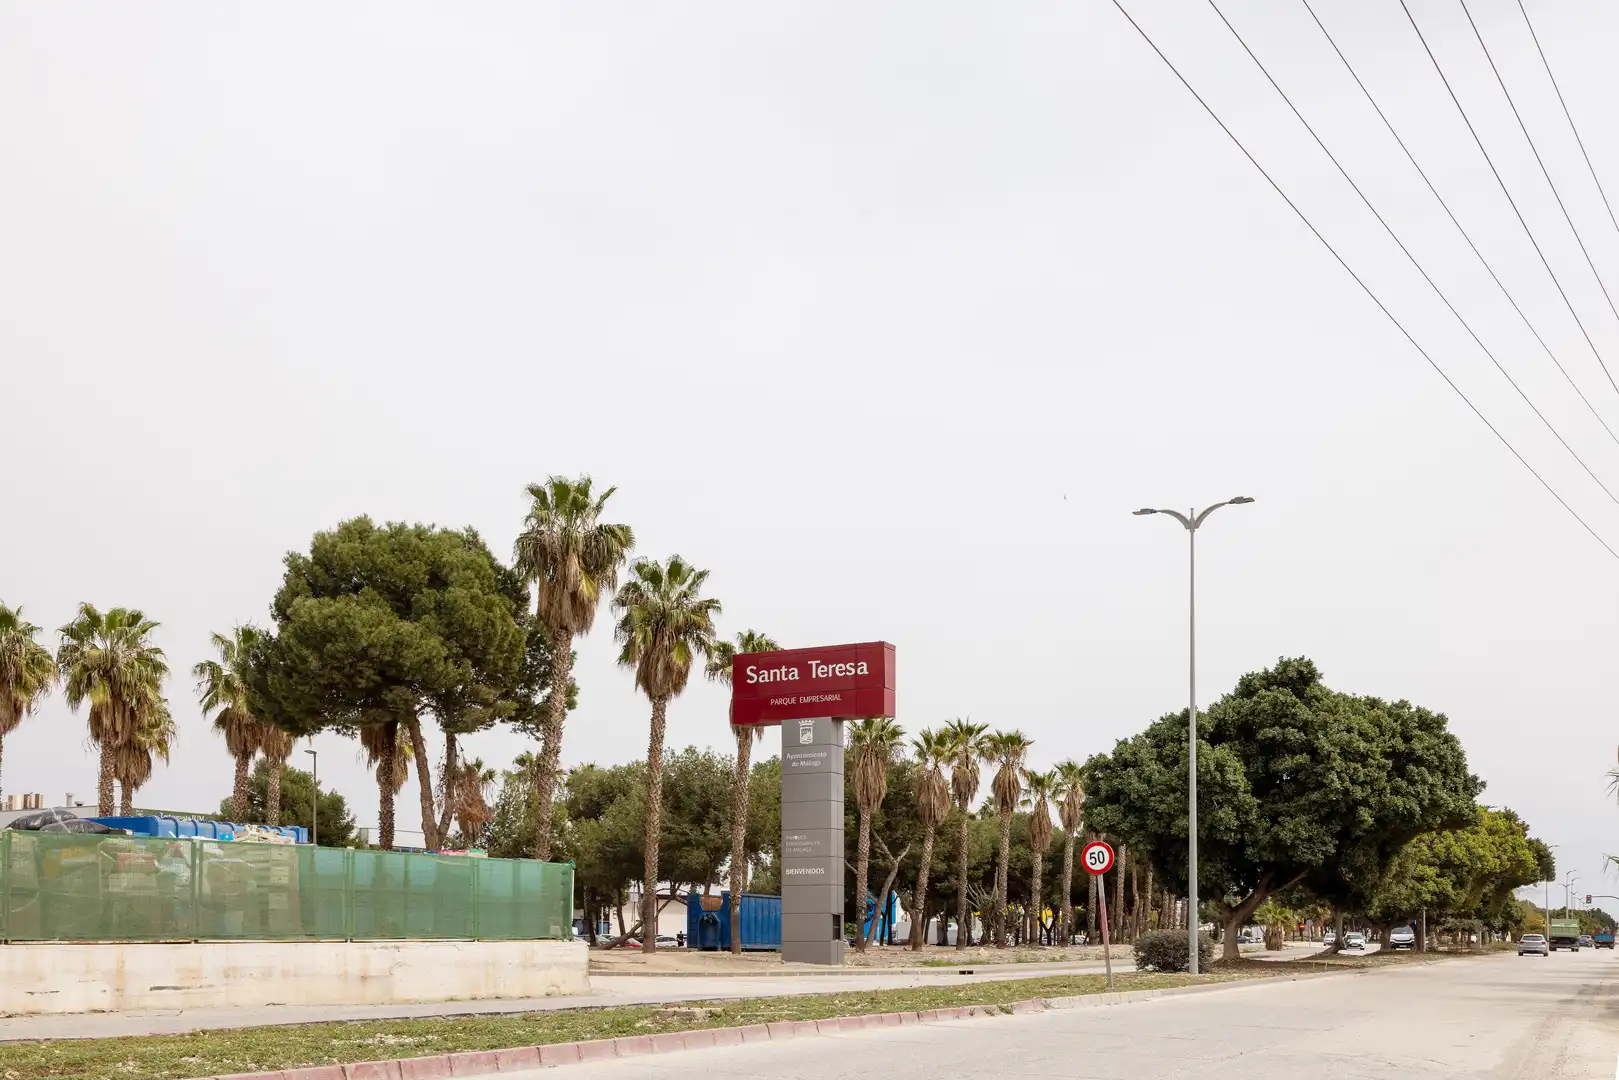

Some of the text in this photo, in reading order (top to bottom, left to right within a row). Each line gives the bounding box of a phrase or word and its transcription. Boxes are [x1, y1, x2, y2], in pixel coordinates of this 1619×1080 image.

[746, 660, 869, 684] Santa Teresa
[770, 694, 842, 706] PARQUE EMPRESARIAL
[1089, 850, 1105, 866] 50
